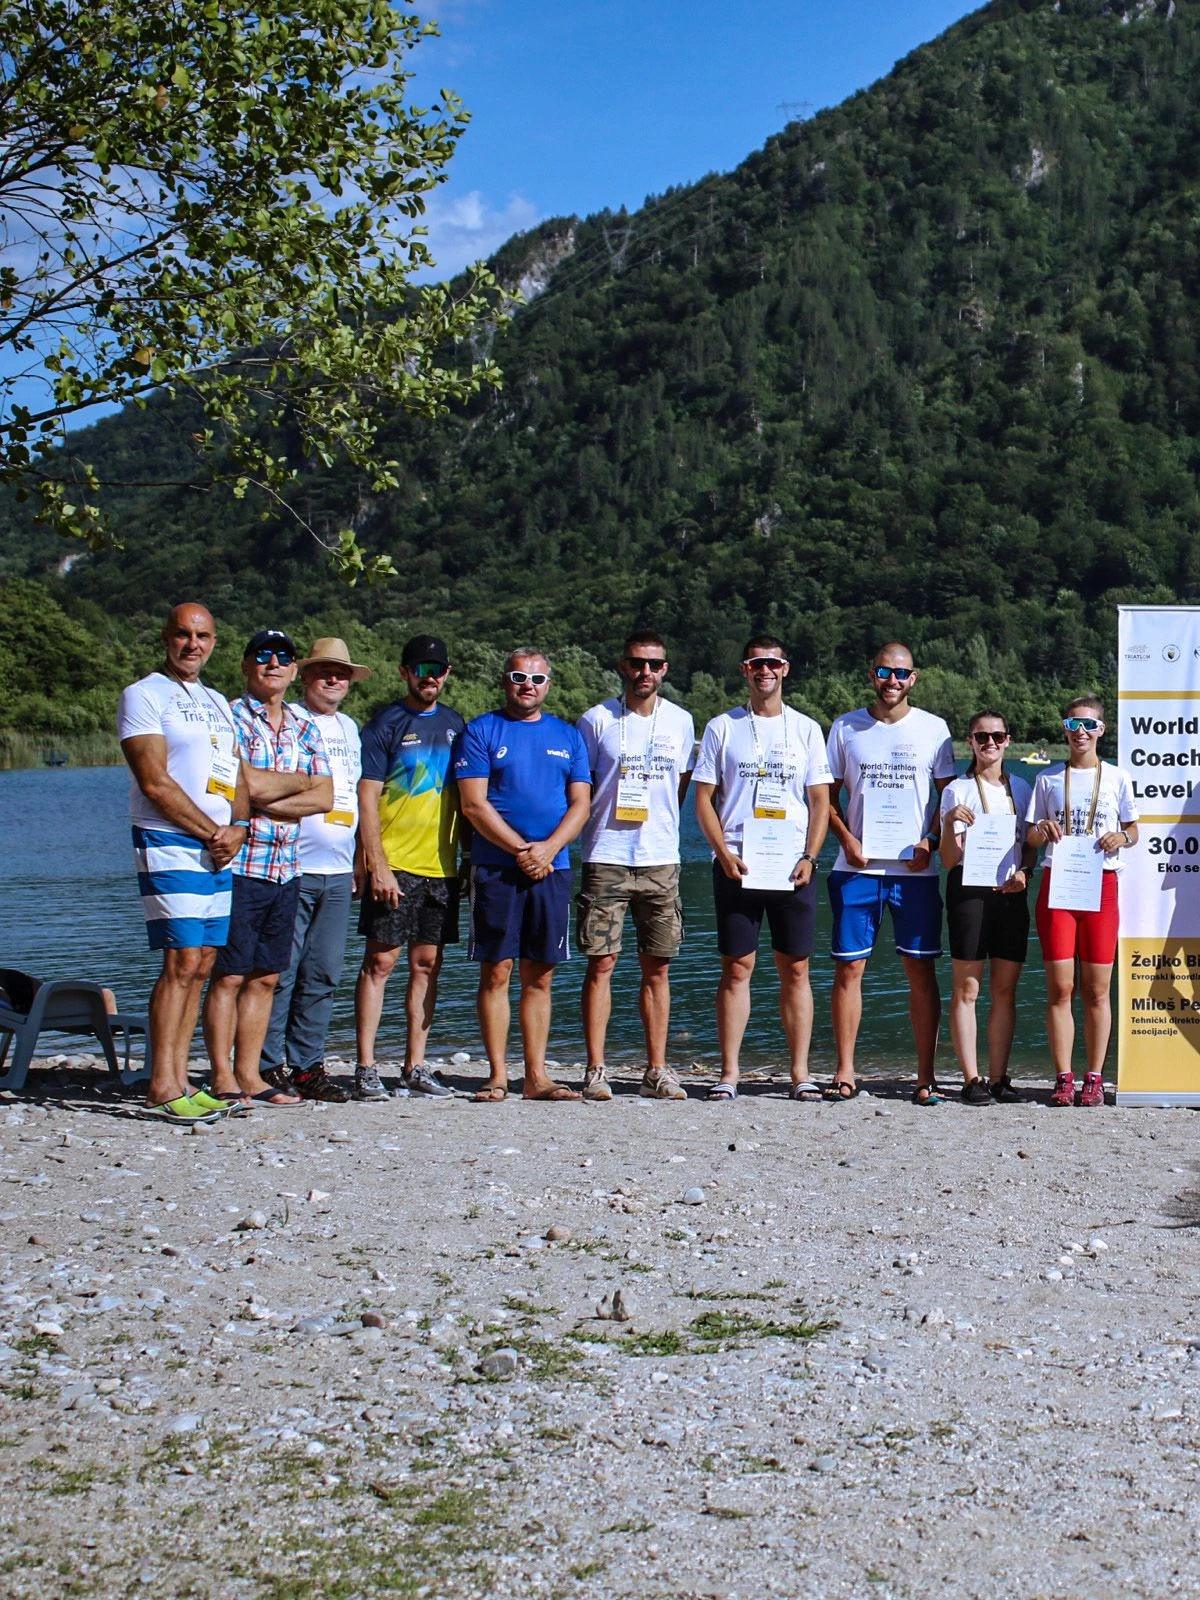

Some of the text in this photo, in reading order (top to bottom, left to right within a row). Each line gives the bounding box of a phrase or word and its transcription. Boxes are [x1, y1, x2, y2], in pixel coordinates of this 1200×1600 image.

[1131, 717, 1199, 735] World
[860, 763, 917, 772] World Triathlon
[895, 772, 915, 780] Level
[877, 781, 904, 789] Course
[1132, 781, 1193, 798] Level
[1157, 863, 1181, 873] Eko
[1131, 951, 1182, 969] Željko
[1131, 973, 1169, 982] Evropski
[1131, 997, 1176, 1011] Miloš
[1131, 1028, 1178, 1036] asocijacije
